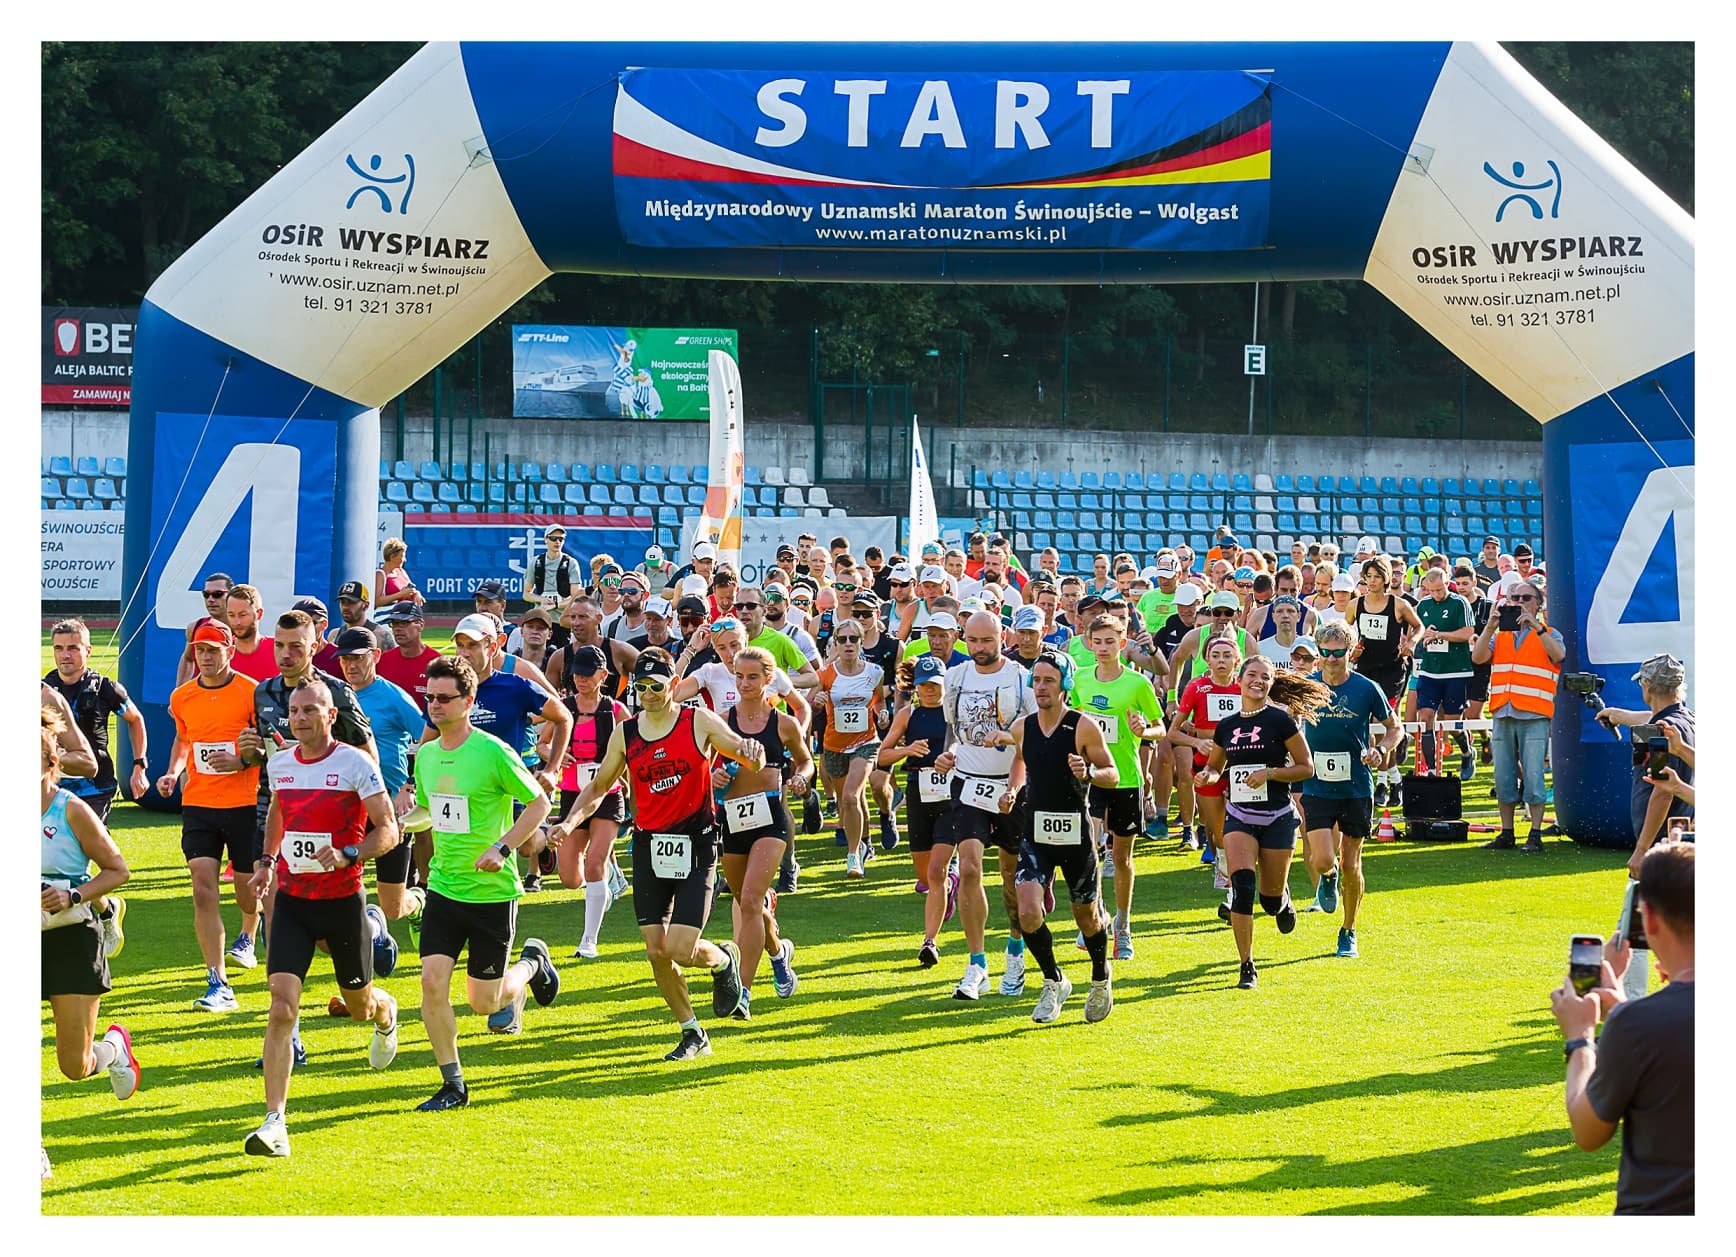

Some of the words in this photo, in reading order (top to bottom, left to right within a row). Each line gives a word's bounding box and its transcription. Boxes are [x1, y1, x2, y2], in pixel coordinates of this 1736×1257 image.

[754, 78, 1131, 150] START
[645, 200, 813, 221] Międzynarodowy
[821, 202, 917, 219] Uznamski
[924, 203, 1007, 220] Maraton
[1014, 200, 1132, 223] Świnoujście
[1158, 203, 1239, 224] Wolgast
[262, 224, 324, 247] OSiR
[339, 228, 490, 259] WYSPIARZ
[816, 226, 1067, 243] www.maratonuznamski.pl
[1412, 244, 1478, 268] OSiR
[1491, 236, 1644, 265] WYSPIARZ
[258, 251, 301, 263] Ośrodek
[304, 254, 341, 267] Sportu
[352, 259, 404, 274] Rekreacji
[408, 265, 417, 274] w
[421, 263, 486, 277] Świnoujściu
[1417, 274, 1459, 285] Ośrodek
[1461, 273, 1497, 286] Sportu
[1509, 268, 1561, 283] Rekreacji
[1564, 269, 1574, 278] w
[1578, 264, 1646, 278] Świnoujściu
[279, 273, 460, 298] www.osir.uznam.net.pl
[1444, 284, 1621, 306] www.osir.uznam.net.pl
[304, 295, 328, 310] tel.
[334, 298, 352, 312] 91
[360, 300, 388, 314] 321
[395, 302, 433, 314] 3781
[1471, 313, 1493, 326] tel.
[1497, 313, 1514, 327] 91
[1520, 311, 1548, 326] 321
[1556, 309, 1595, 324] 3781
[85, 322, 137, 353] BE
[54, 364, 87, 378] ALEJA
[89, 365, 126, 376] BALTIC
[1248, 353, 1262, 372] E
[73, 389, 122, 401] ZAMAWIAJ
[155, 442, 322, 638] 4
[43, 560, 116, 570] SPORTOWY
[427, 578, 463, 593] PORT
[1442, 610, 1449, 618] 2
[1368, 618, 1380, 628] 13
[1218, 699, 1234, 710] 86
[843, 712, 859, 723] 32
[1326, 758, 1336, 771] 6
[655, 777, 675, 789] GAIN
[930, 772, 947, 785] 68
[975, 783, 995, 799] 52
[442, 802, 450, 819] 4
[457, 812, 460, 820] 1
[736, 801, 755, 818] 27
[1043, 818, 1072, 833] 805
[293, 840, 315, 858] 39
[656, 840, 685, 857] 204
